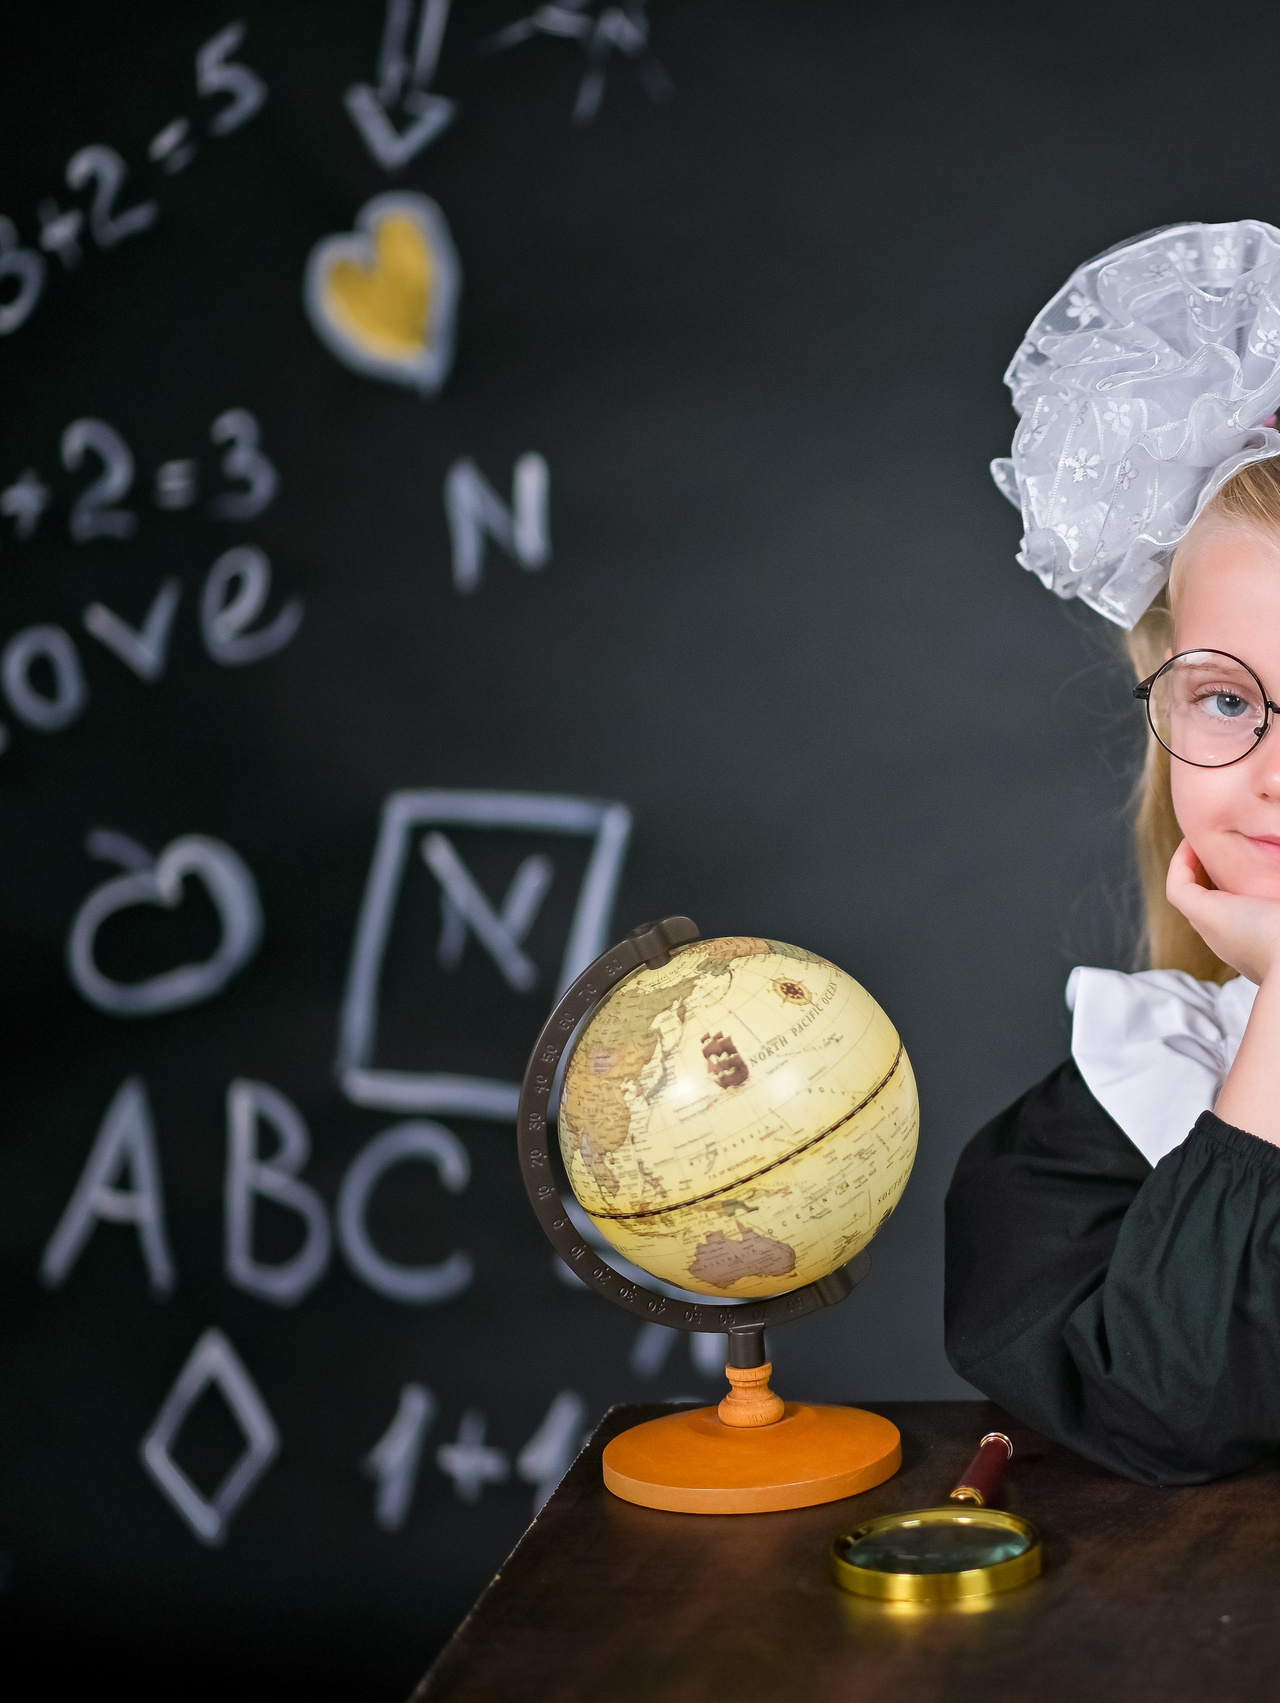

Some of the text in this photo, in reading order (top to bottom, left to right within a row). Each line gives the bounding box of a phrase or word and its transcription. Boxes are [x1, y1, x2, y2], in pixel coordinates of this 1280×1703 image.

[0, 545, 303, 737] ove
[749, 1036, 788, 1068] NORTH
[791, 1004, 824, 1037] PACIFIC
[821, 979, 838, 1005] OCEAN
